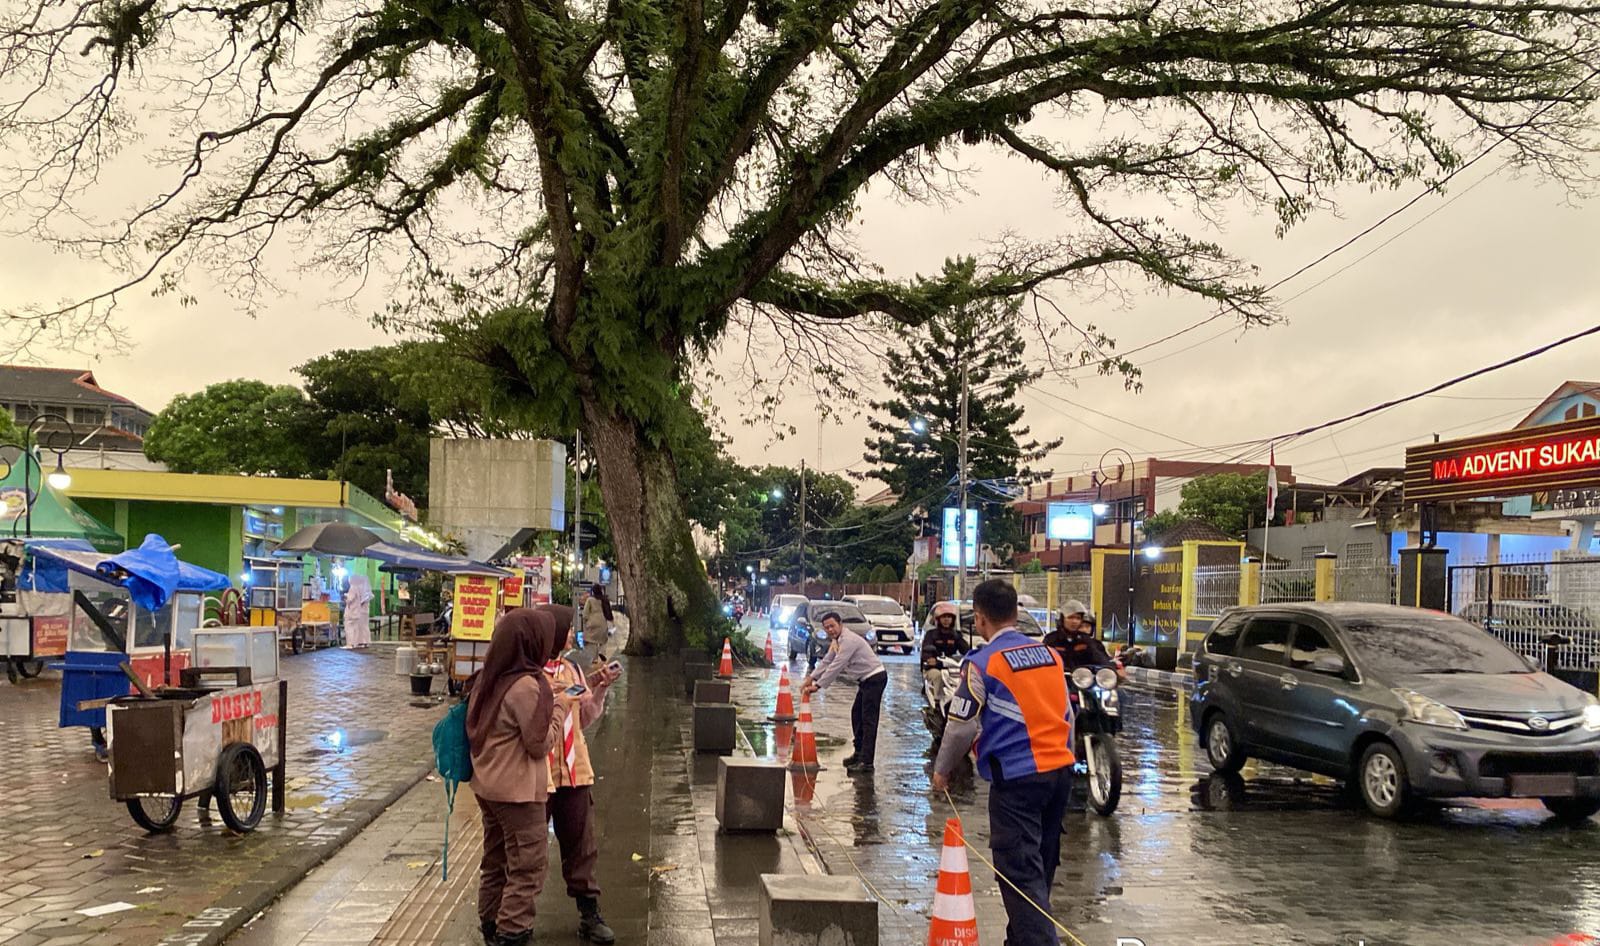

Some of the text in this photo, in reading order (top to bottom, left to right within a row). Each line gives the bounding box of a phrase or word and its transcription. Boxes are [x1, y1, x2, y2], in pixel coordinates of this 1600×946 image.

[1434, 459, 1458, 479] MA
[1462, 448, 1536, 477] ADVENT
[1004, 645, 1055, 669] DISHUB
